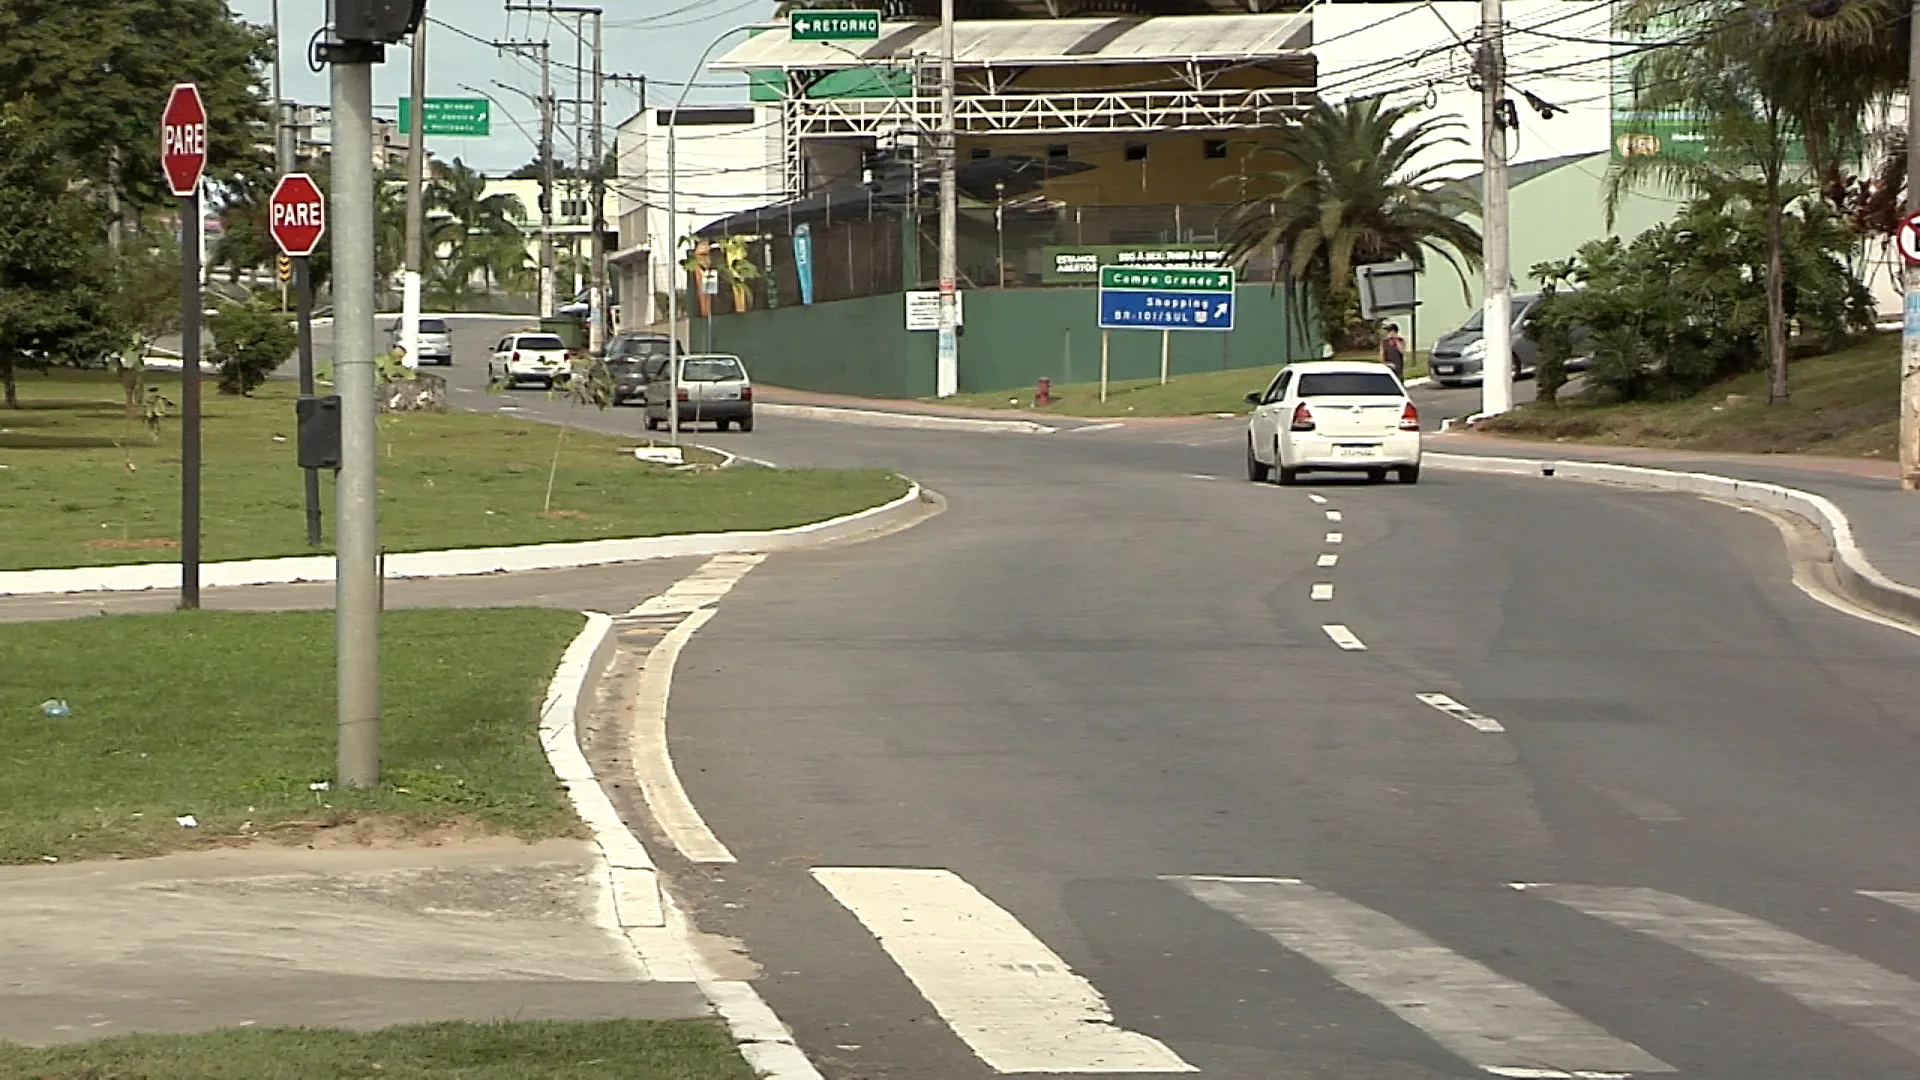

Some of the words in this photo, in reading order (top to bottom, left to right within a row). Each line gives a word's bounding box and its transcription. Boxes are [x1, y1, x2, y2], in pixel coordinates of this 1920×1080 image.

[812, 19, 877, 32] RETORNO
[164, 123, 204, 155] PARE
[273, 203, 322, 226] PARE
[1113, 273, 1158, 285] Campo
[1164, 275, 1213, 286] Grande
[1146, 297, 1209, 310] Shopping
